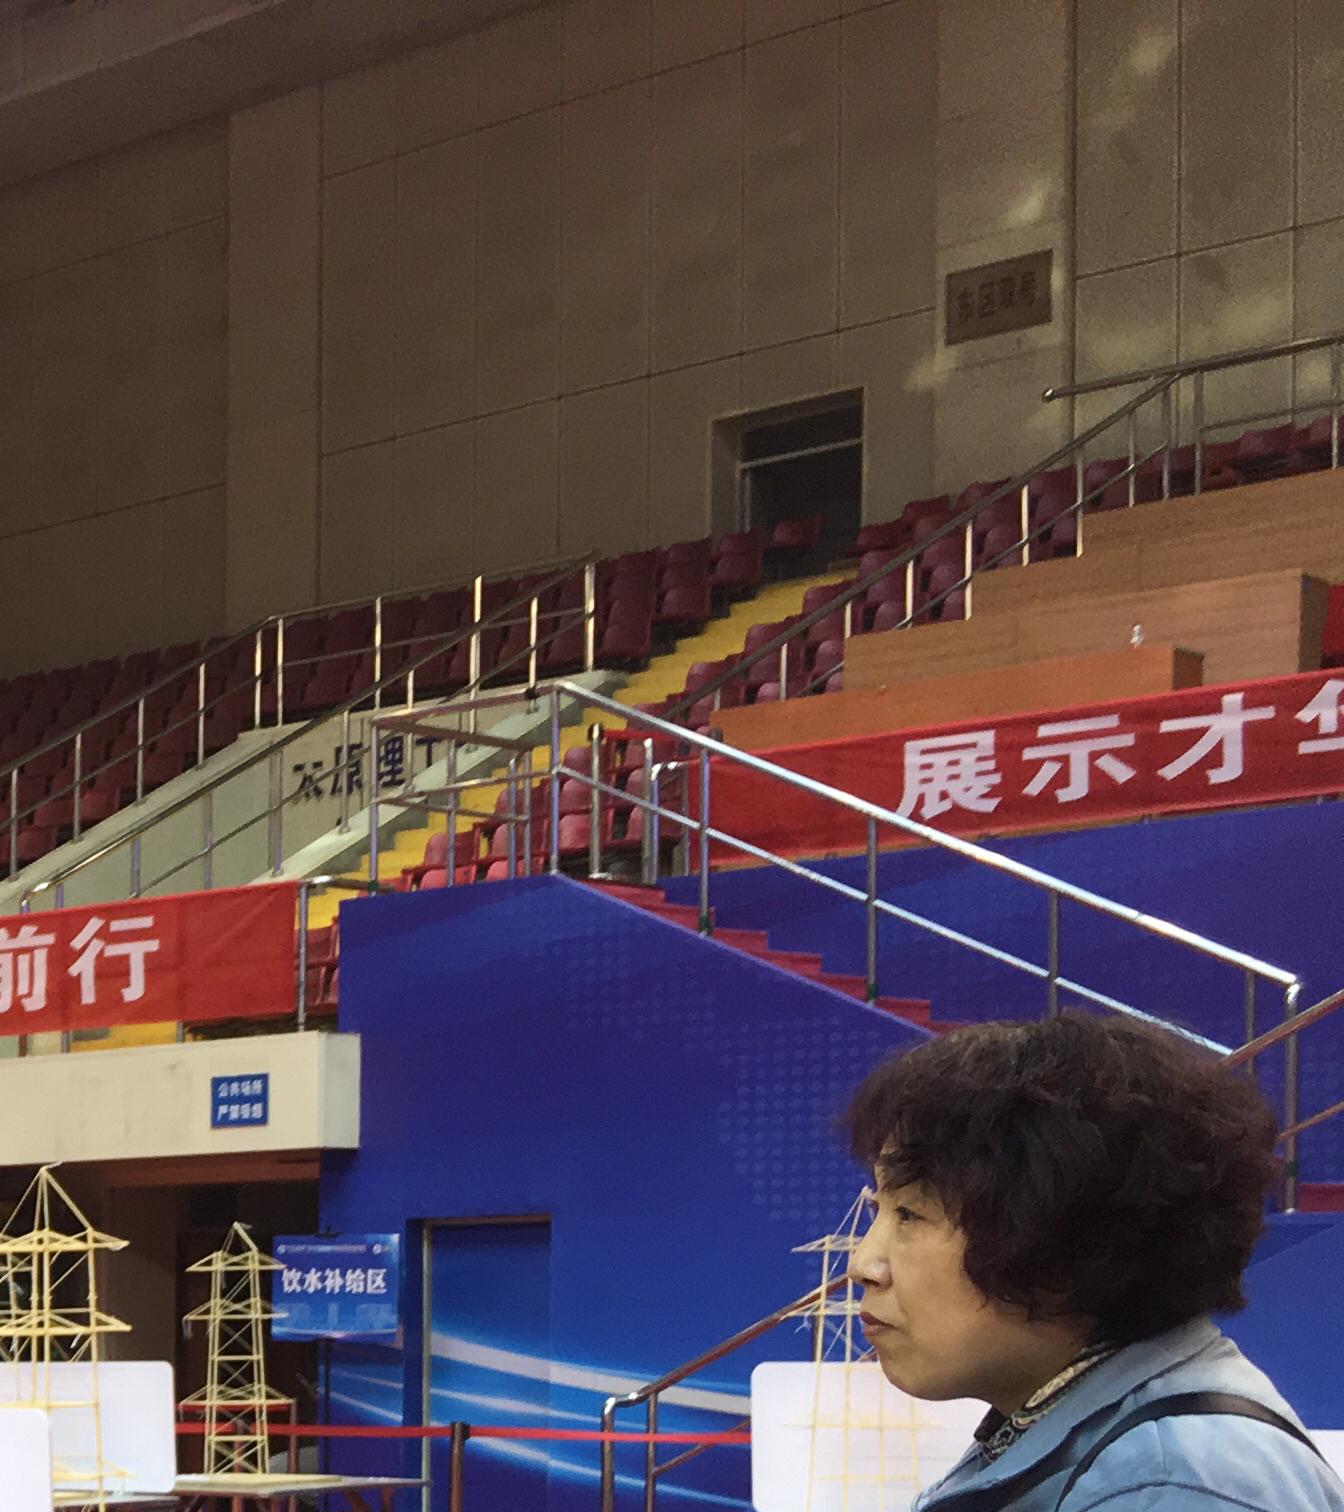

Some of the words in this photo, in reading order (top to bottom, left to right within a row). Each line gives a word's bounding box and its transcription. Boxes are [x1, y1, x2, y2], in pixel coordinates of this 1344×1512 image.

[281, 1268, 387, 1294] 饮水补给区
